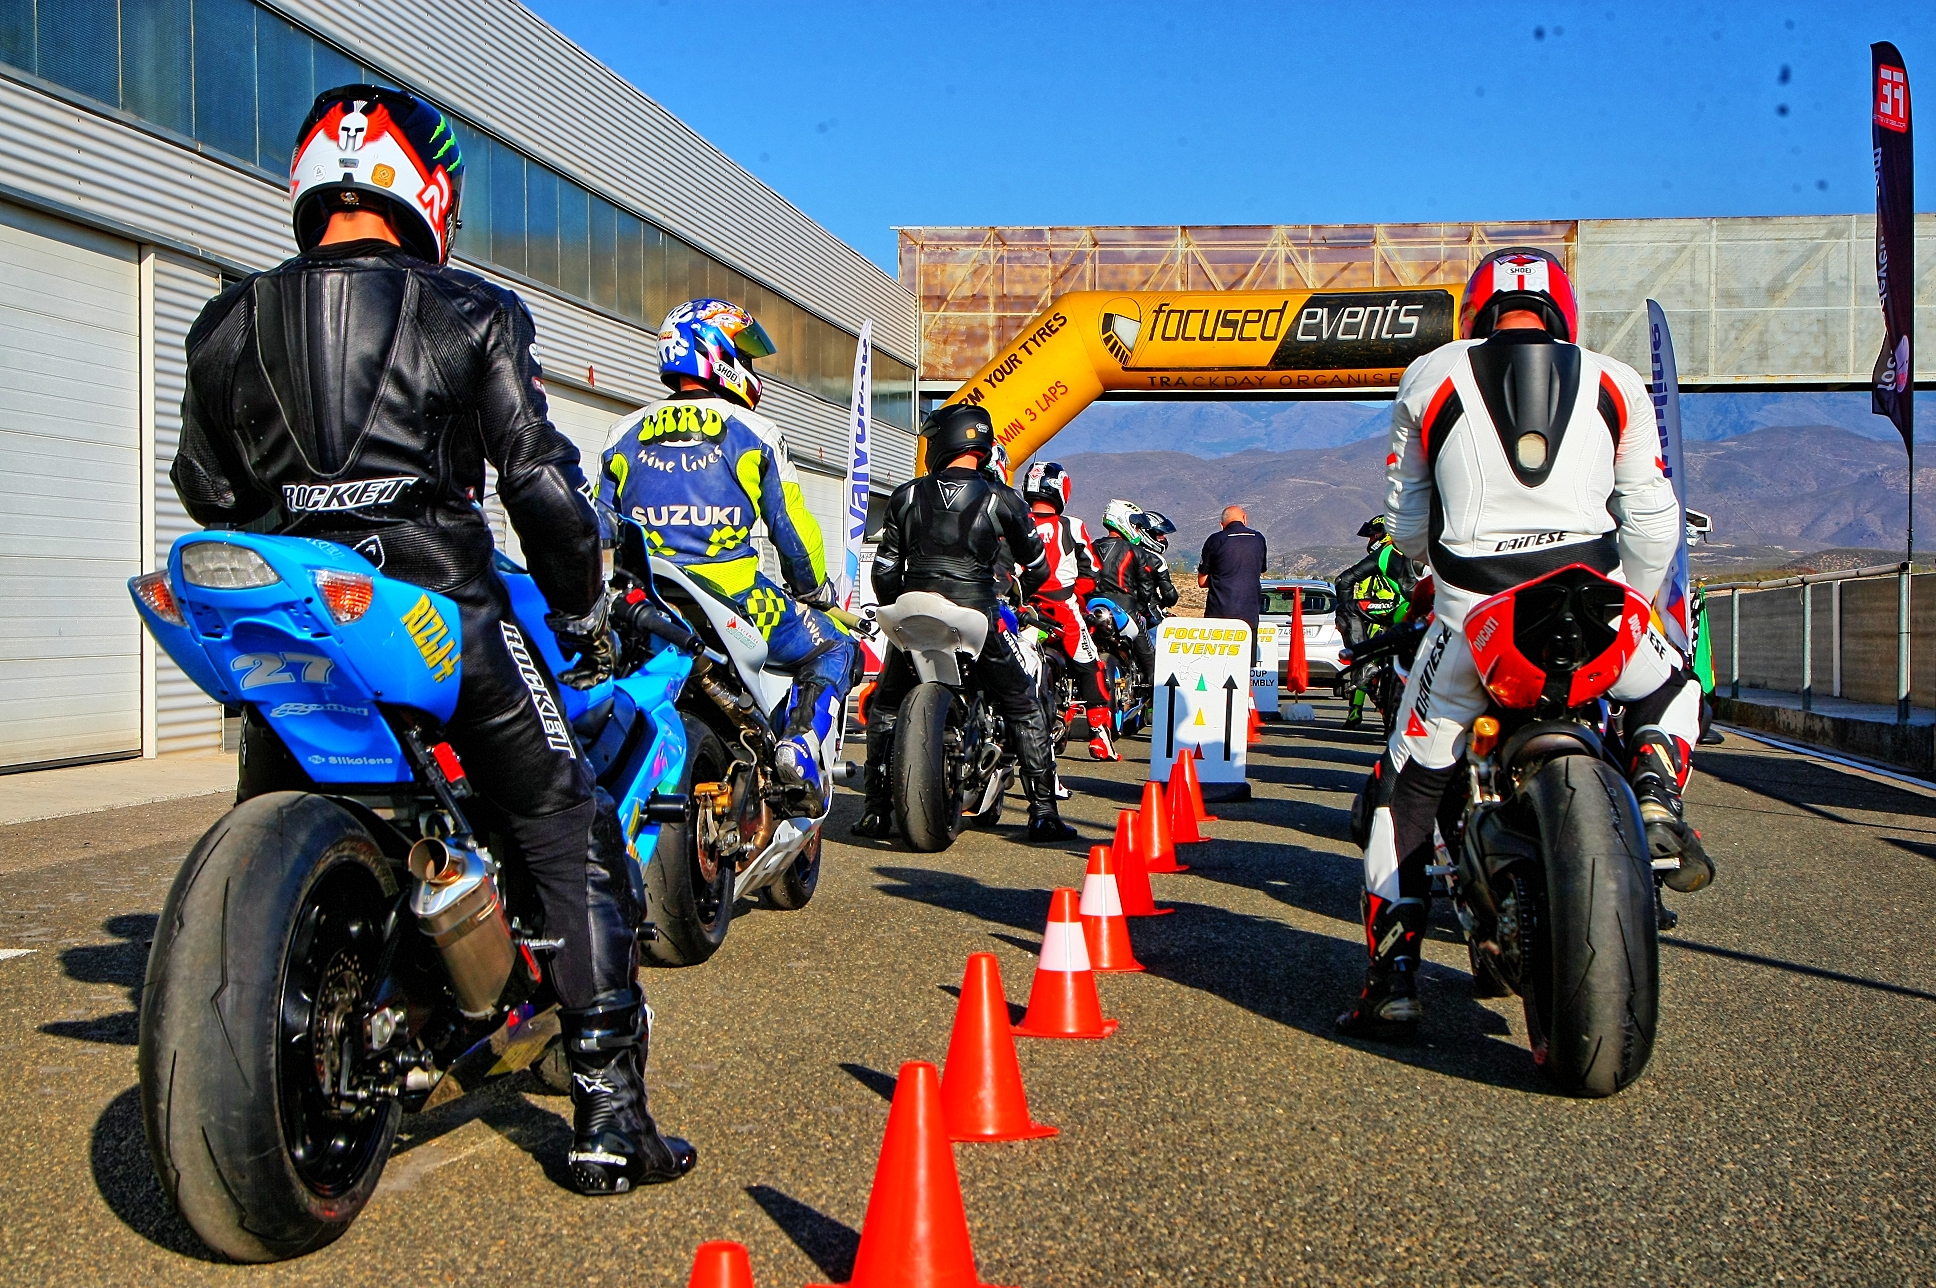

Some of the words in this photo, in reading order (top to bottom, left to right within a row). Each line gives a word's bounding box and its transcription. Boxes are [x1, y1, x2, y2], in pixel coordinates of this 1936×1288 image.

[1149, 300, 1289, 342] focused
[1296, 298, 1424, 342] events
[983, 352, 1023, 389] YOUR
[1018, 312, 1068, 356] TYRES
[716, 362, 738, 383] SHOEI
[1148, 374, 1268, 388] TRACKDAY
[1279, 372, 1402, 386] ORGANISE
[997, 418, 1026, 447] MIN
[1025, 407, 1037, 422] 3
[1035, 380, 1069, 413] LAPS
[638, 449, 676, 473] nine
[681, 445, 723, 472] lives
[282, 476, 420, 512] ROCKET
[631, 505, 742, 527] SUZUKI
[400, 592, 462, 684] RIZLA+
[1163, 626, 1248, 641] FOCUSED
[1473, 616, 1499, 653] DUCATI
[1168, 642, 1241, 656] EVENTS
[230, 652, 335, 690] 27
[1250, 669, 1267, 678] OUP
[1251, 679, 1275, 687] MBLY
[499, 620, 577, 760] ROCKET
[328, 756, 394, 765] Silkolene
